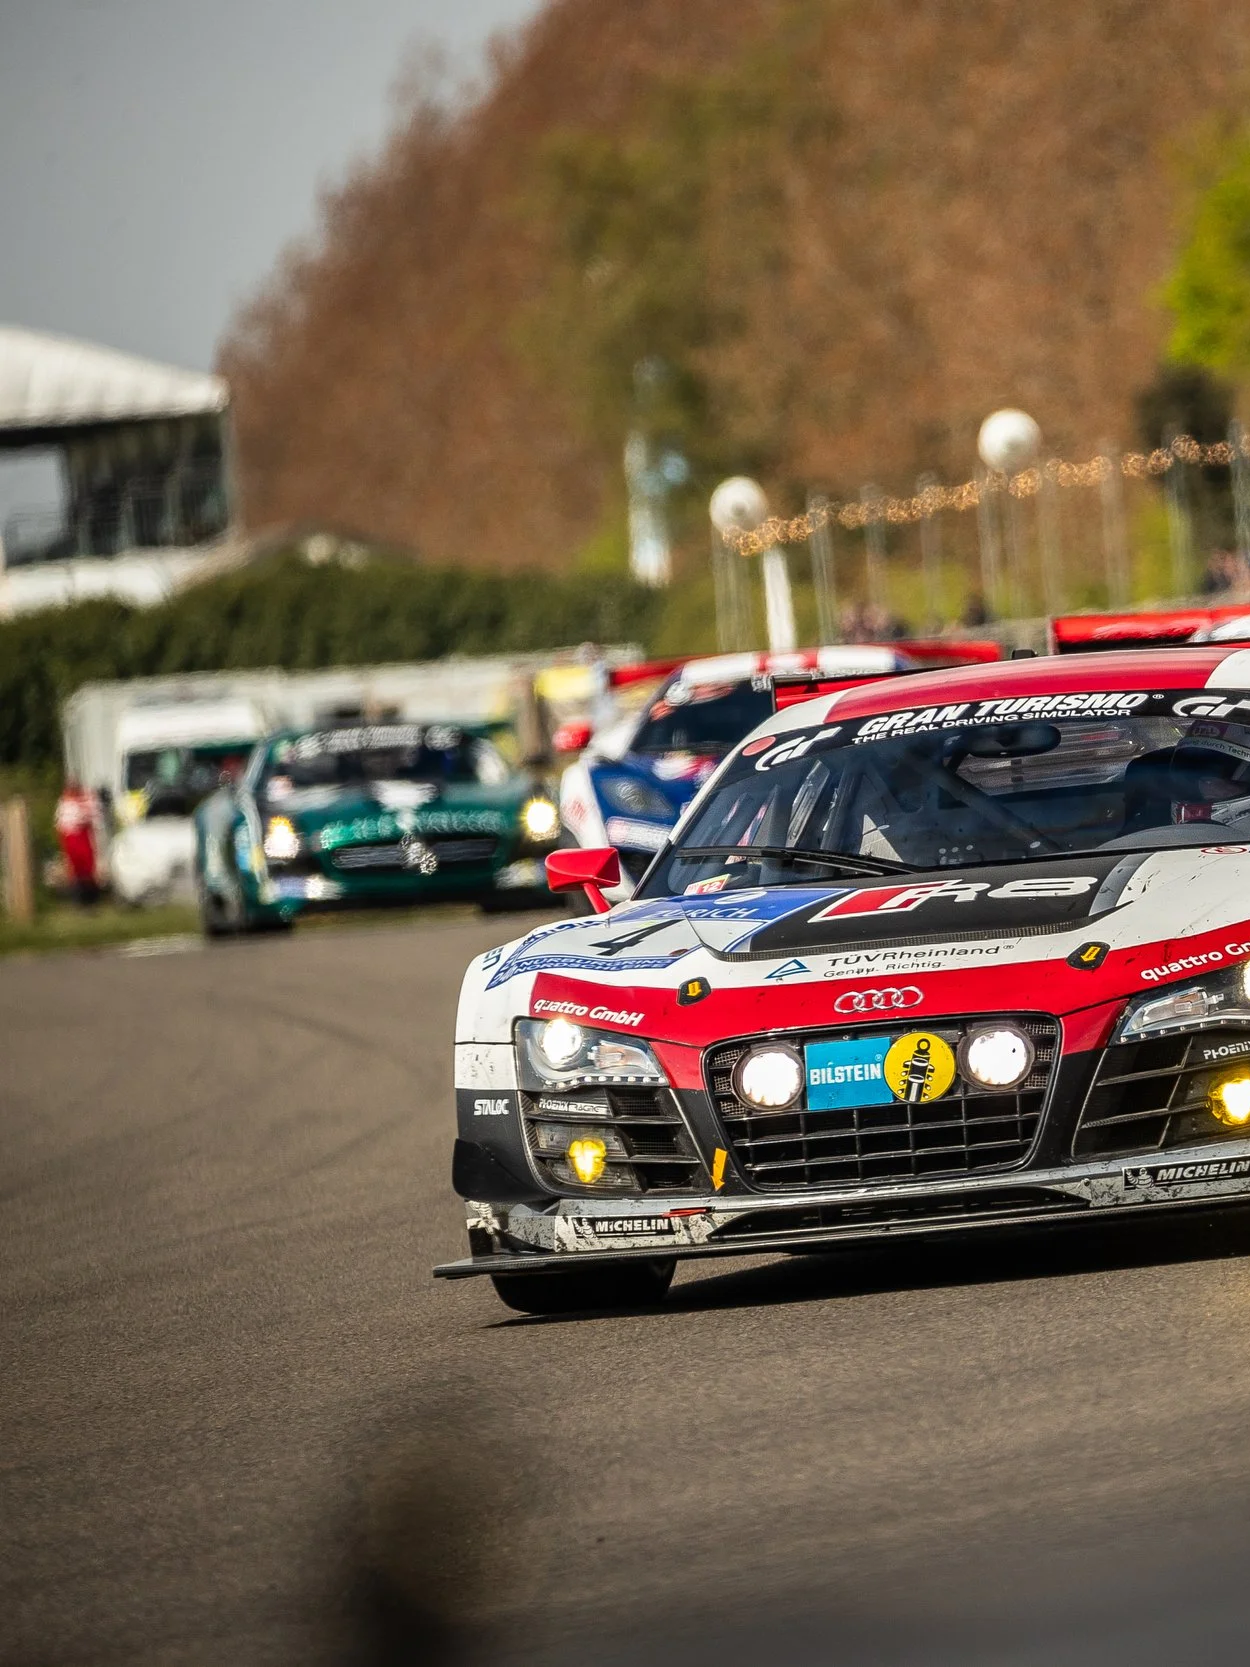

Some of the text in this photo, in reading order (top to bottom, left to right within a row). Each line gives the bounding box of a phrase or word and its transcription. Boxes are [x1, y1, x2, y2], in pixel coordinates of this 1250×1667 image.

[851, 708, 1132, 745] THE REAL DRIVING SIMULATOR
[856, 693, 1150, 736] GRAN TURISMO
[876, 877, 1098, 912] R8
[587, 919, 685, 956] 4
[885, 960, 947, 971] Richtig.
[1139, 950, 1223, 982] quattro
[533, 999, 645, 1027] quattro GmbH
[809, 1062, 883, 1086] BILSTEIN
[473, 1098, 510, 1116] STALOC
[1156, 1160, 1250, 1181] MICHELIN
[595, 1218, 669, 1233] MICHELIN
